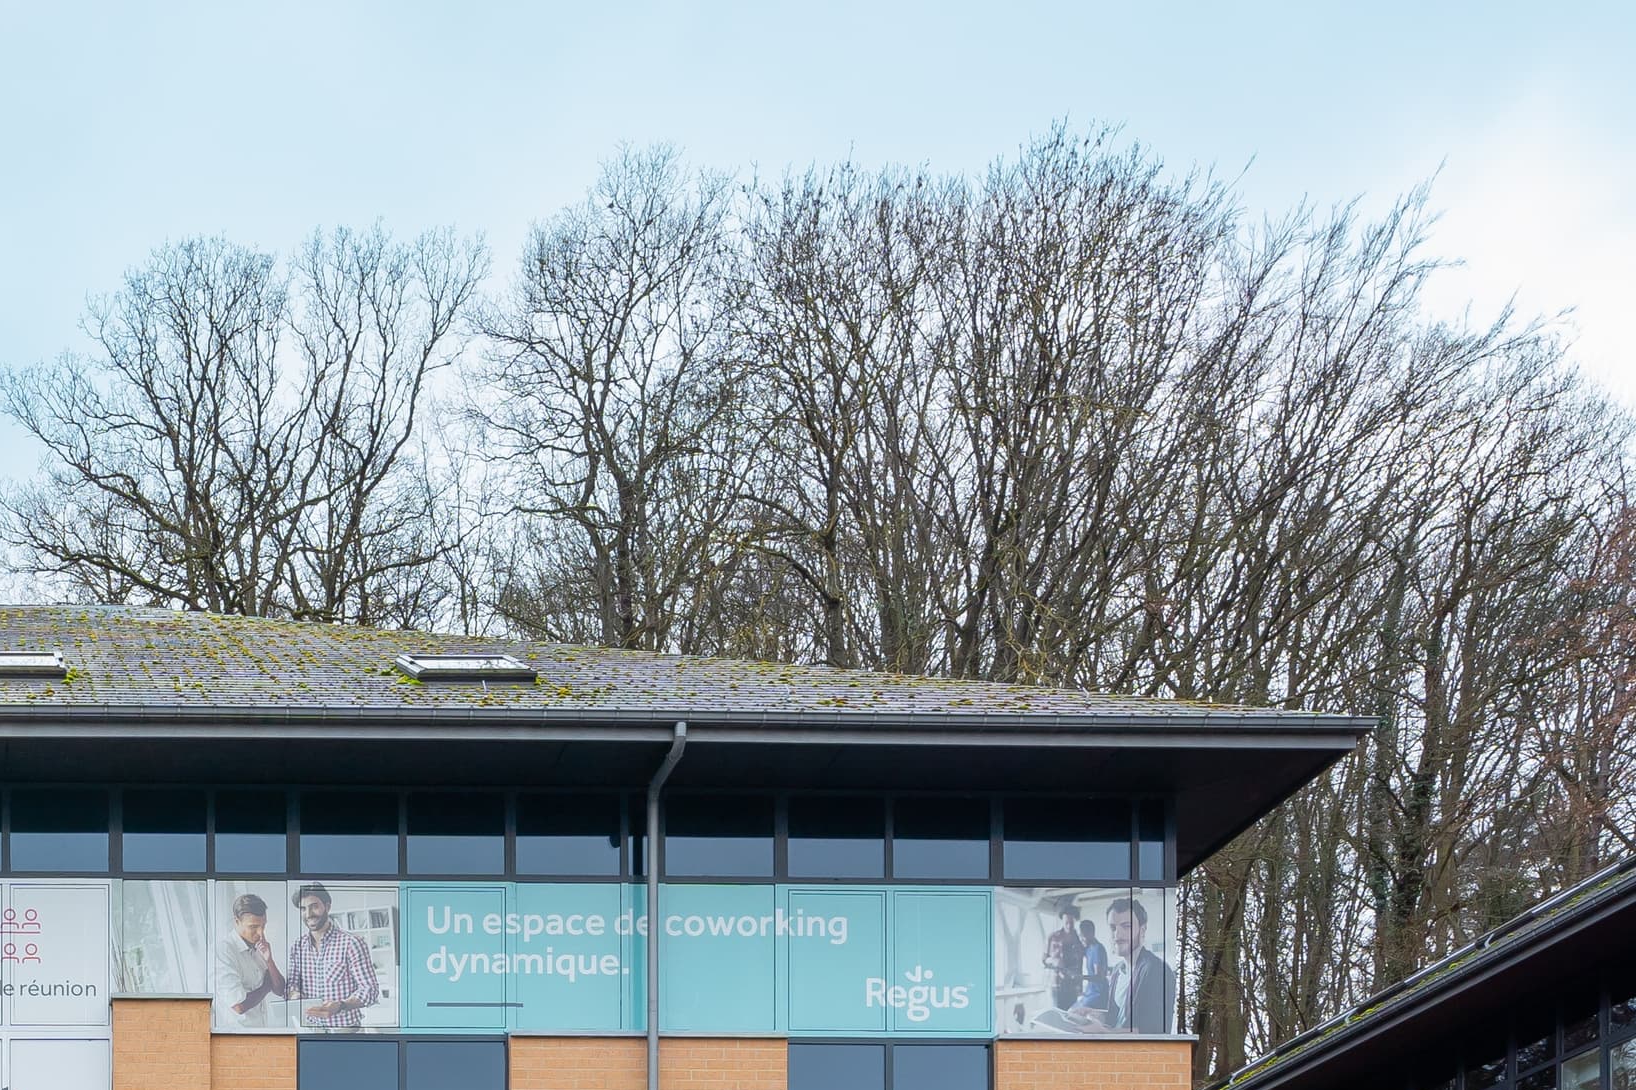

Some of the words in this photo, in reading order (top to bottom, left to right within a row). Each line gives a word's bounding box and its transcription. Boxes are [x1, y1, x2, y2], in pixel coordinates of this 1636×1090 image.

[427, 906, 474, 936] Un
[483, 911, 604, 942] espace
[613, 908, 649, 936] de
[665, 908, 848, 945] coworking
[426, 944, 630, 983] dynamique.
[19, 979, 97, 997] réunion
[866, 965, 970, 1022] Regus
